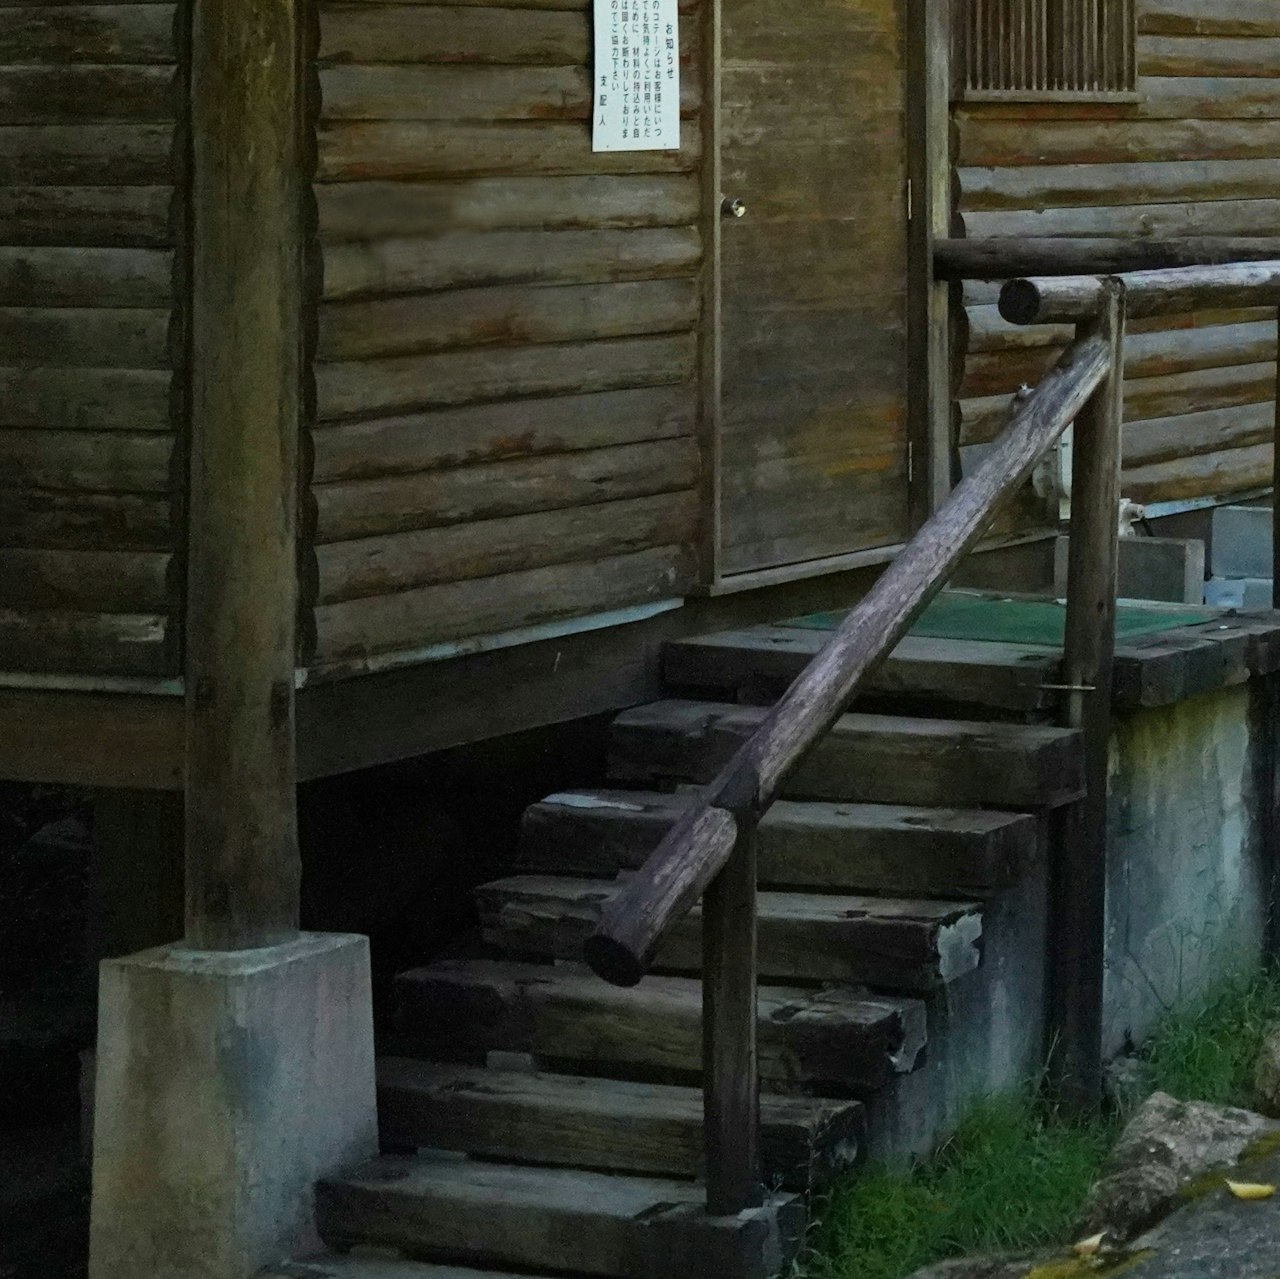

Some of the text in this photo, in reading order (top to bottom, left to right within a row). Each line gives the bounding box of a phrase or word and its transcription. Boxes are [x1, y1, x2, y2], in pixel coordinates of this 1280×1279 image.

[666, 24, 674, 79] お知らせ
[599, 76, 607, 127] 支配人
